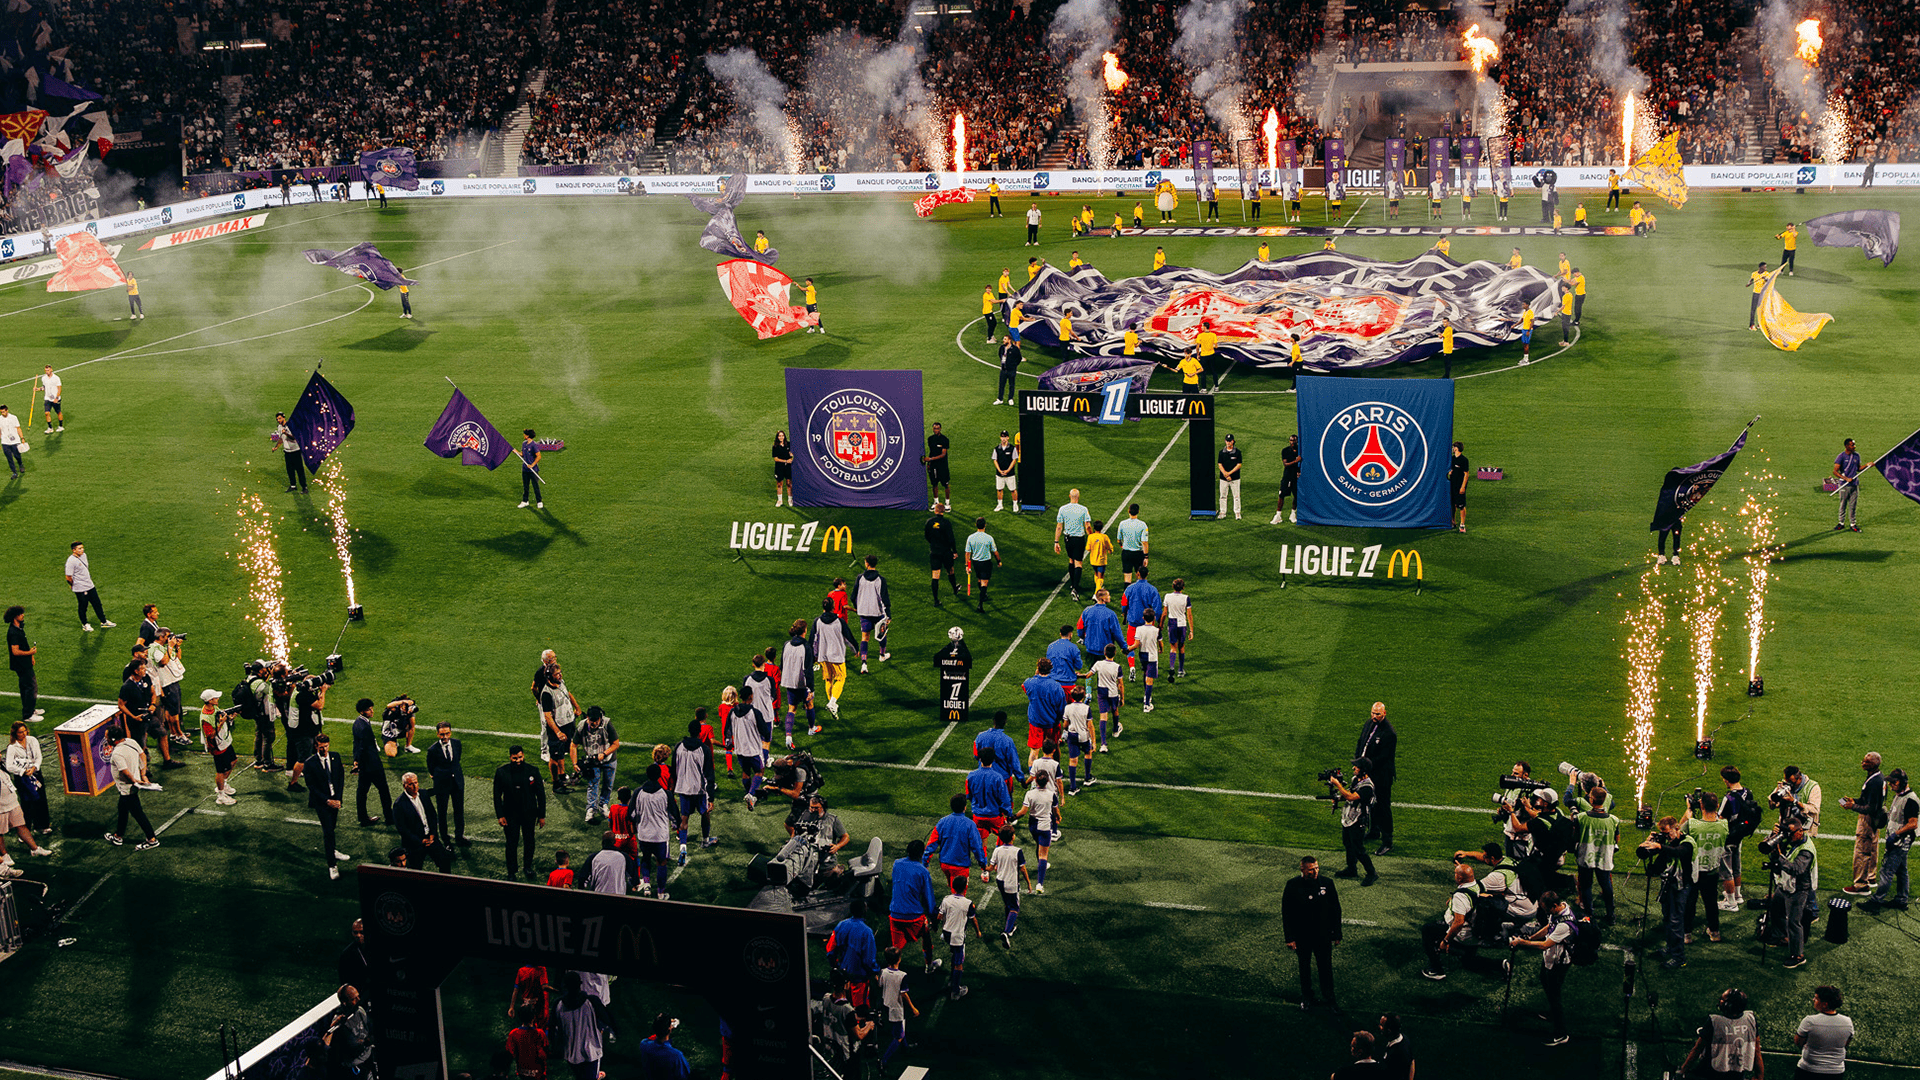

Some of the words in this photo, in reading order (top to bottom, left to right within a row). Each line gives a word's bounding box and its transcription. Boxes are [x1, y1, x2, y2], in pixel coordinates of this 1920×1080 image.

[1710, 172, 1745, 180] BANQUE
[186, 205, 205, 214] BANQUE
[206, 200, 232, 211] POPULAIRE
[170, 216, 252, 245] WINAMAX
[821, 395, 888, 417] TOULOUSE
[1026, 396, 1060, 412] LIGUE
[1140, 399, 1174, 414] LIGUE
[1337, 406, 1410, 433] PARIS
[812, 434, 822, 442] 19
[888, 436, 900, 444] 37
[820, 454, 870, 483] FOOTBALL
[870, 456, 895, 480] CLUB
[1337, 475, 1363, 496] SAINT
[1369, 478, 1408, 498] GERMAIN
[730, 521, 796, 551] LIGUE
[1279, 544, 1355, 576] LIGUE
[1699, 833, 1720, 841] LFP
[484, 906, 575, 954] LIGUE
[1726, 1024, 1748, 1036] LFP
